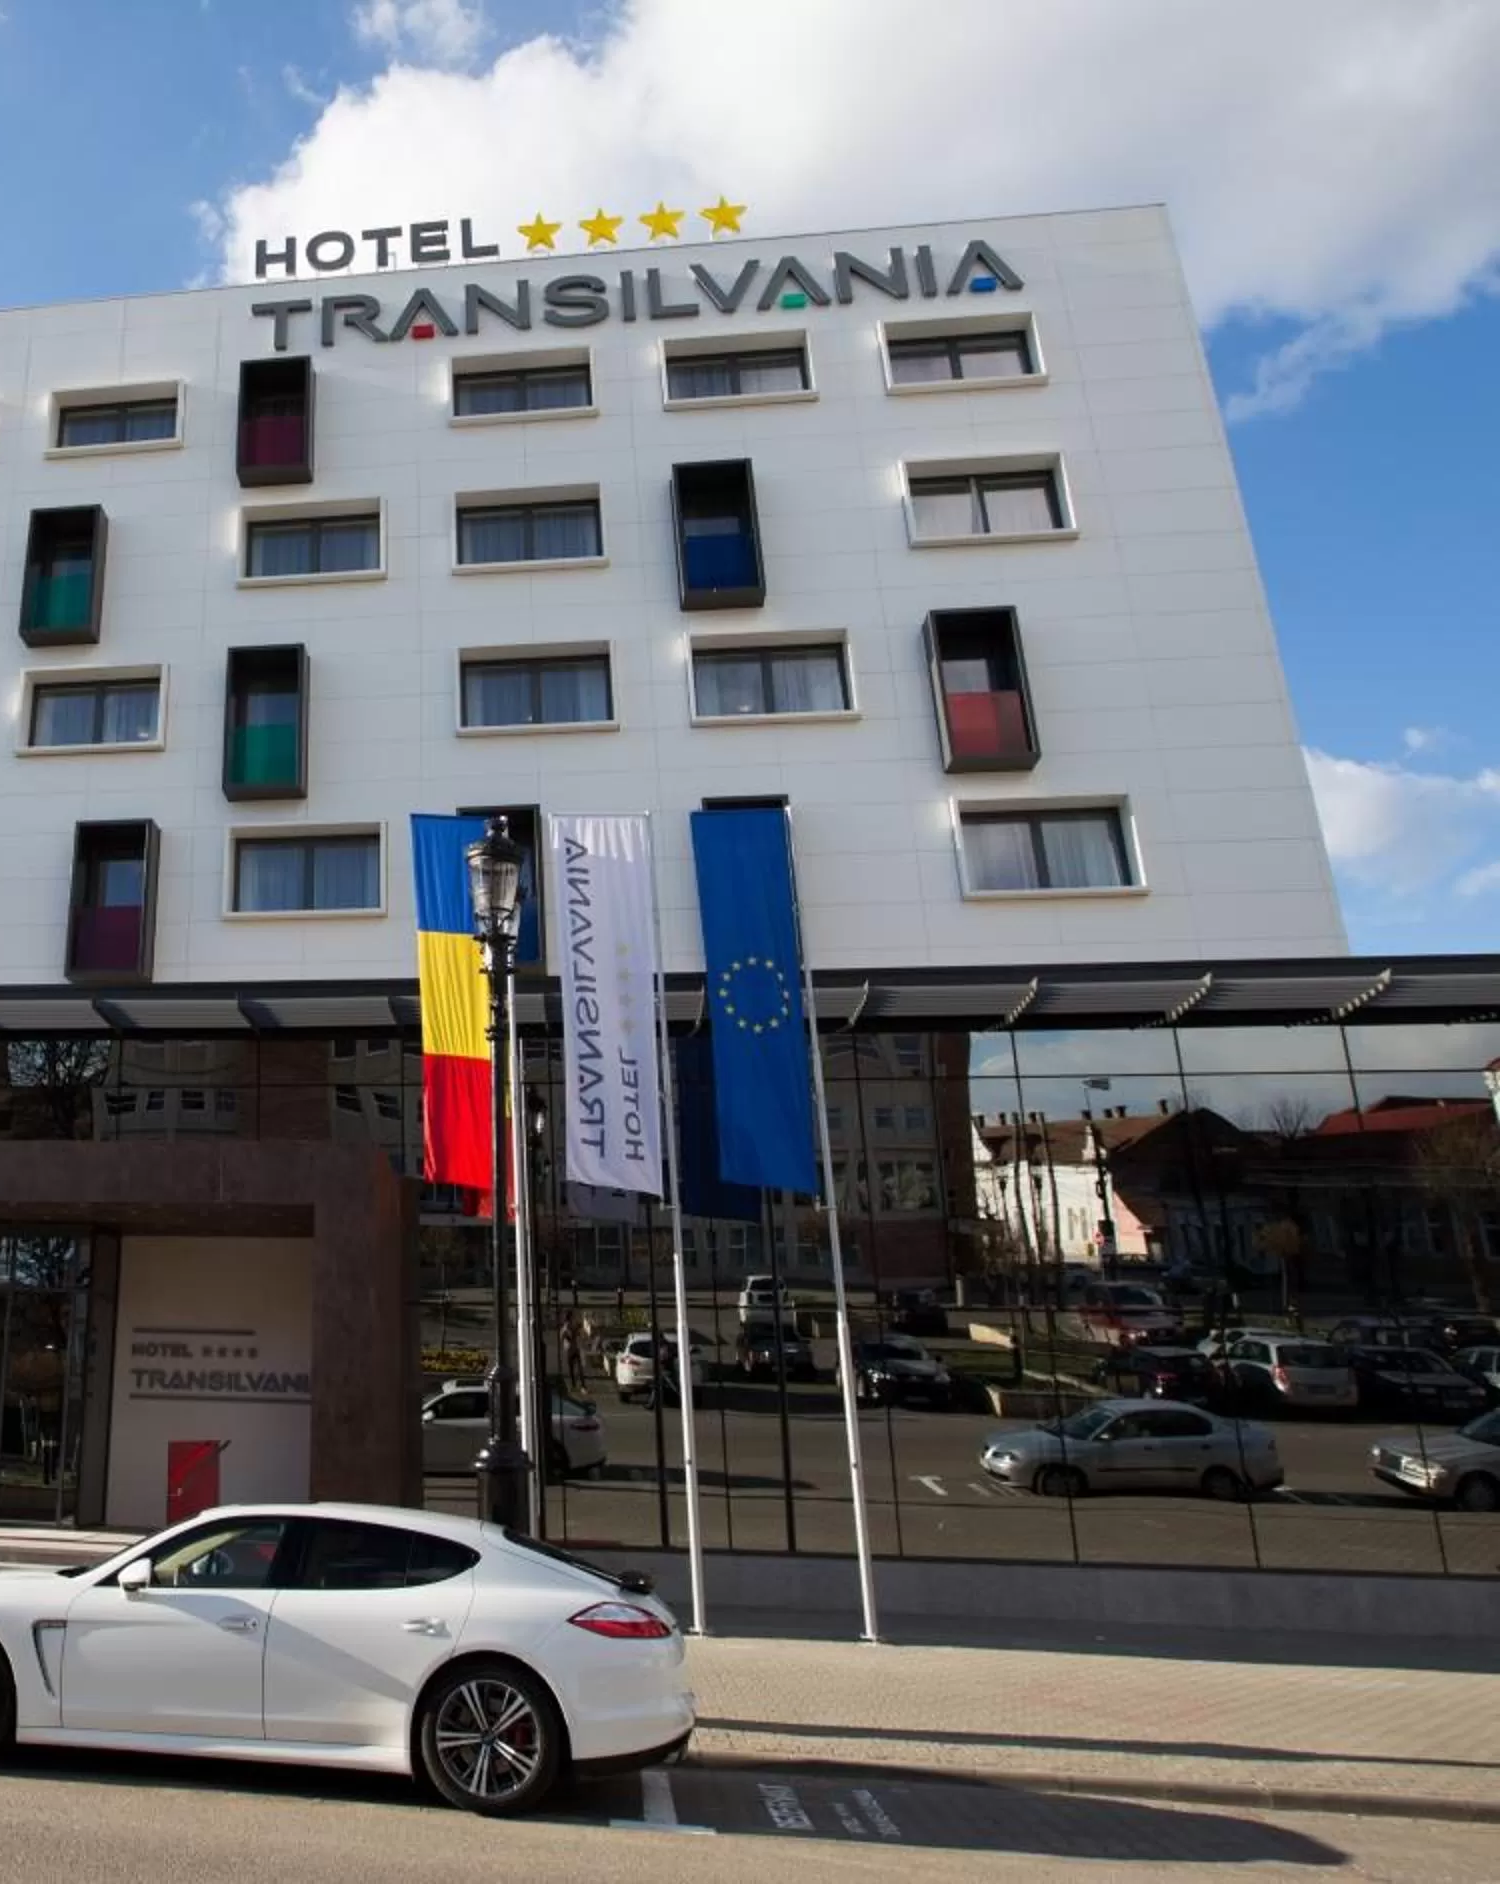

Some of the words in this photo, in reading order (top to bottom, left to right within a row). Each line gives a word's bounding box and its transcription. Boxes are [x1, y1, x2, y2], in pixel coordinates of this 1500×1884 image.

[254, 218, 498, 278] HOTEL
[252, 239, 1024, 351] TRANSILVANIA
[131, 1343, 193, 1357] HOTEL
[130, 1369, 310, 1392] TRANSILVANI
